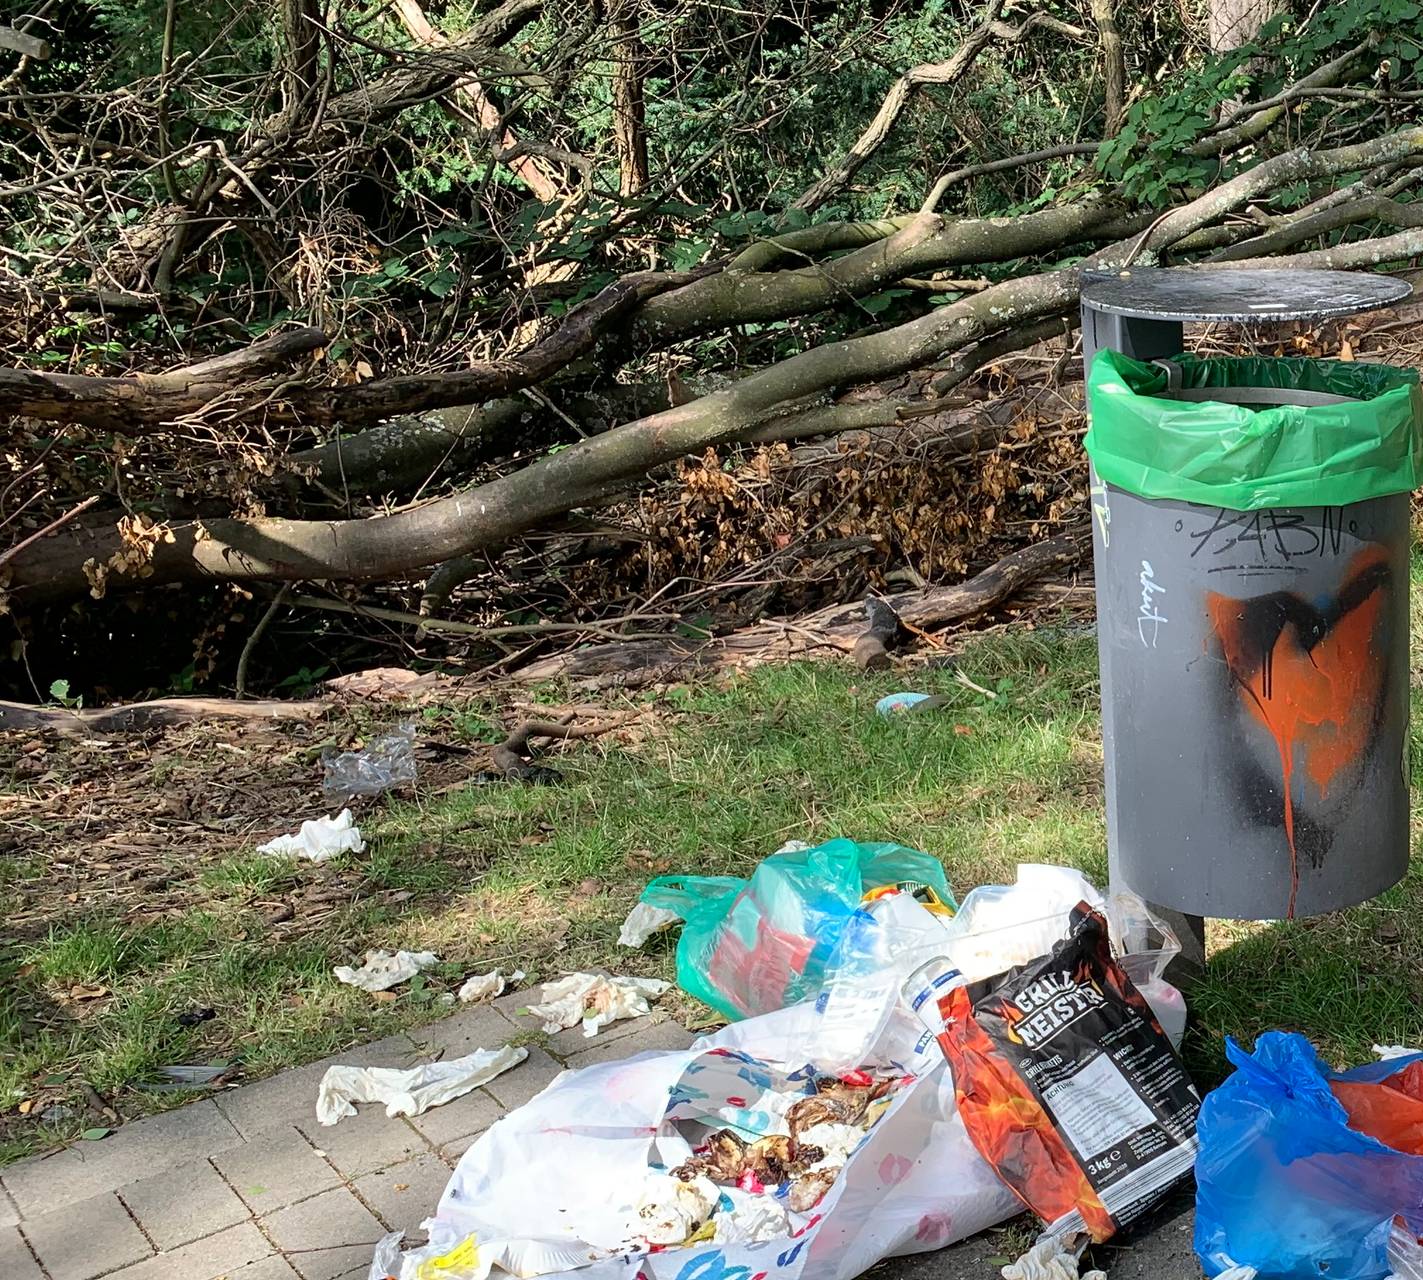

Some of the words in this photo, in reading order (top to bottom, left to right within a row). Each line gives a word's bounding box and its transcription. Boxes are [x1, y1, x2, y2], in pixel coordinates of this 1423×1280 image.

[1014, 970, 1075, 1013] GRILL
[1087, 1163, 1098, 1176] 3
[1095, 1156, 1112, 1172] kg
